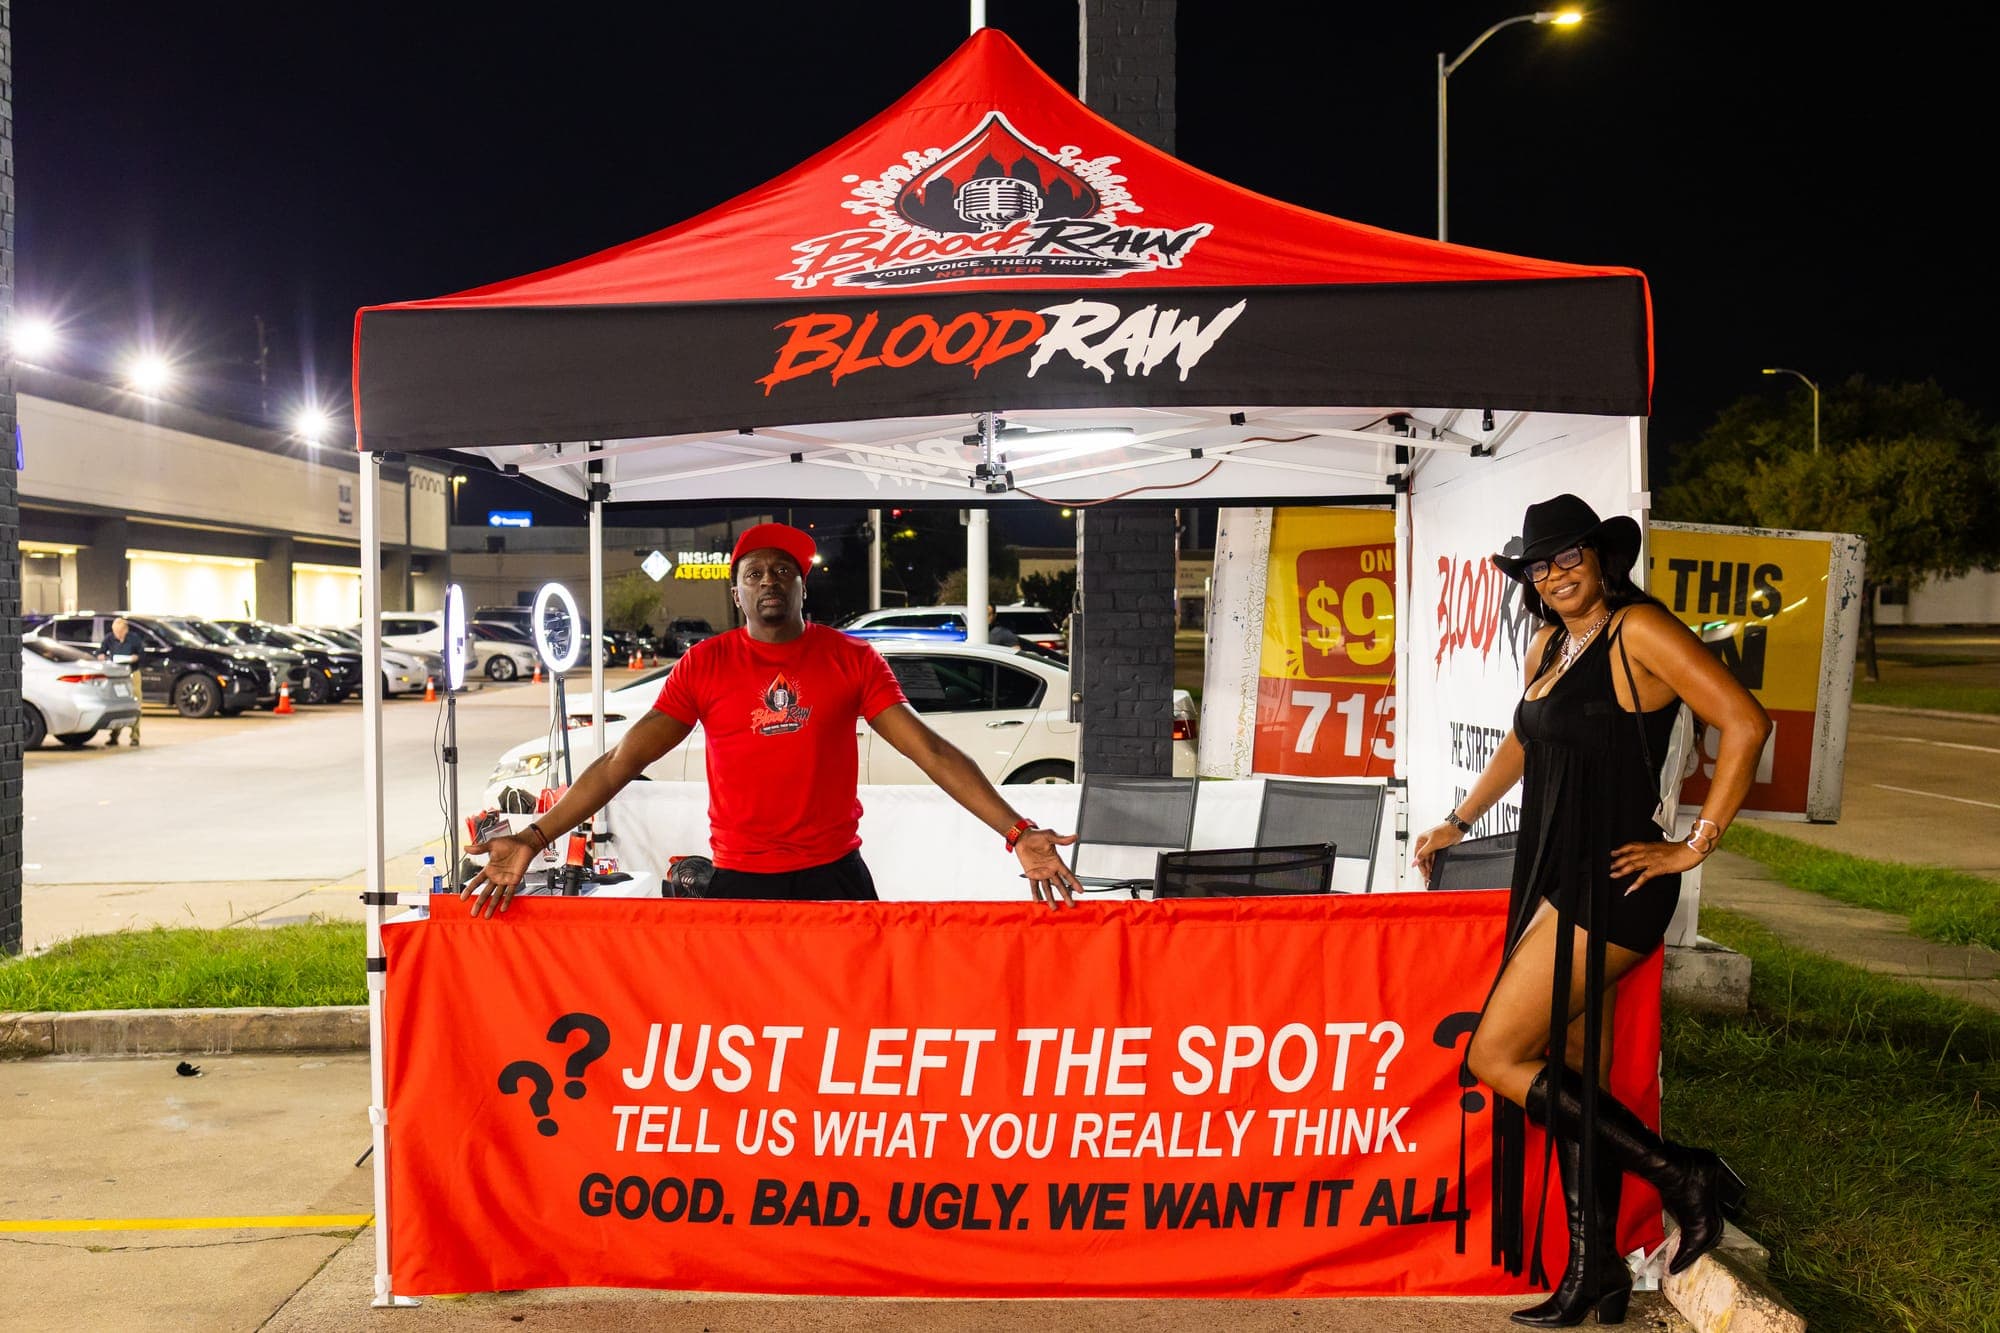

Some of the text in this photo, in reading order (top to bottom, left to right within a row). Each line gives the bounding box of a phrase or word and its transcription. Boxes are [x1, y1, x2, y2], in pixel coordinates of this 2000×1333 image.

[874, 268, 921, 279] YOUR
[926, 260, 984, 272] VOICE.
[1046, 259, 1113, 267] TRUTH.
[935, 270, 966, 279] NO
[1668, 558, 1784, 619] THIS
[622, 1020, 1405, 1097] JUST LEFT THE SPOT?
[612, 1105, 1418, 1160] TELL US WHAT YOU REALLY THINK.
[579, 1172, 1471, 1231] GOOD. BAD. UGLY. WE WANT IT ALL
